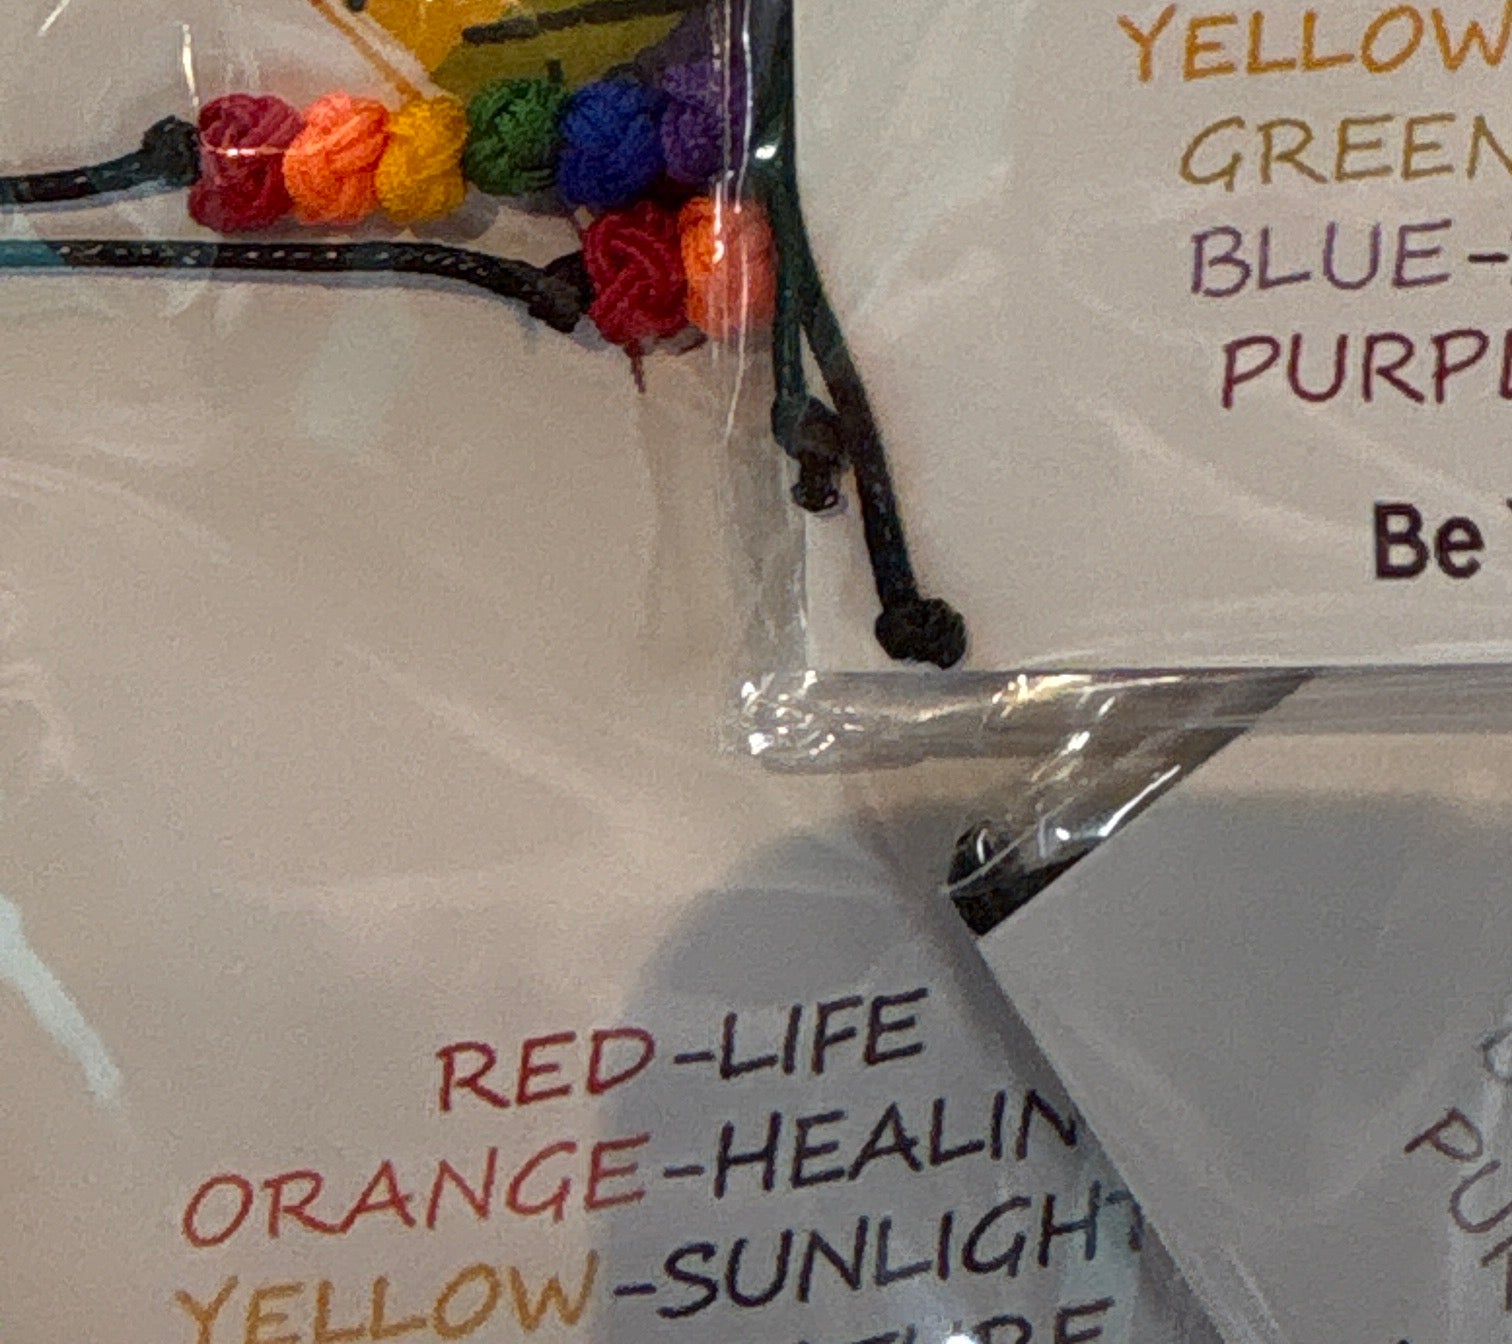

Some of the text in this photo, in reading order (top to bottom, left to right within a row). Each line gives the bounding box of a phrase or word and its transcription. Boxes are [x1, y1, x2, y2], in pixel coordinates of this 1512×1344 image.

[1373, 502, 1485, 580] Be
[434, 986, 929, 1115] RED-LIFE
[180, 1088, 1079, 1250] ORANGE-HEALIN
